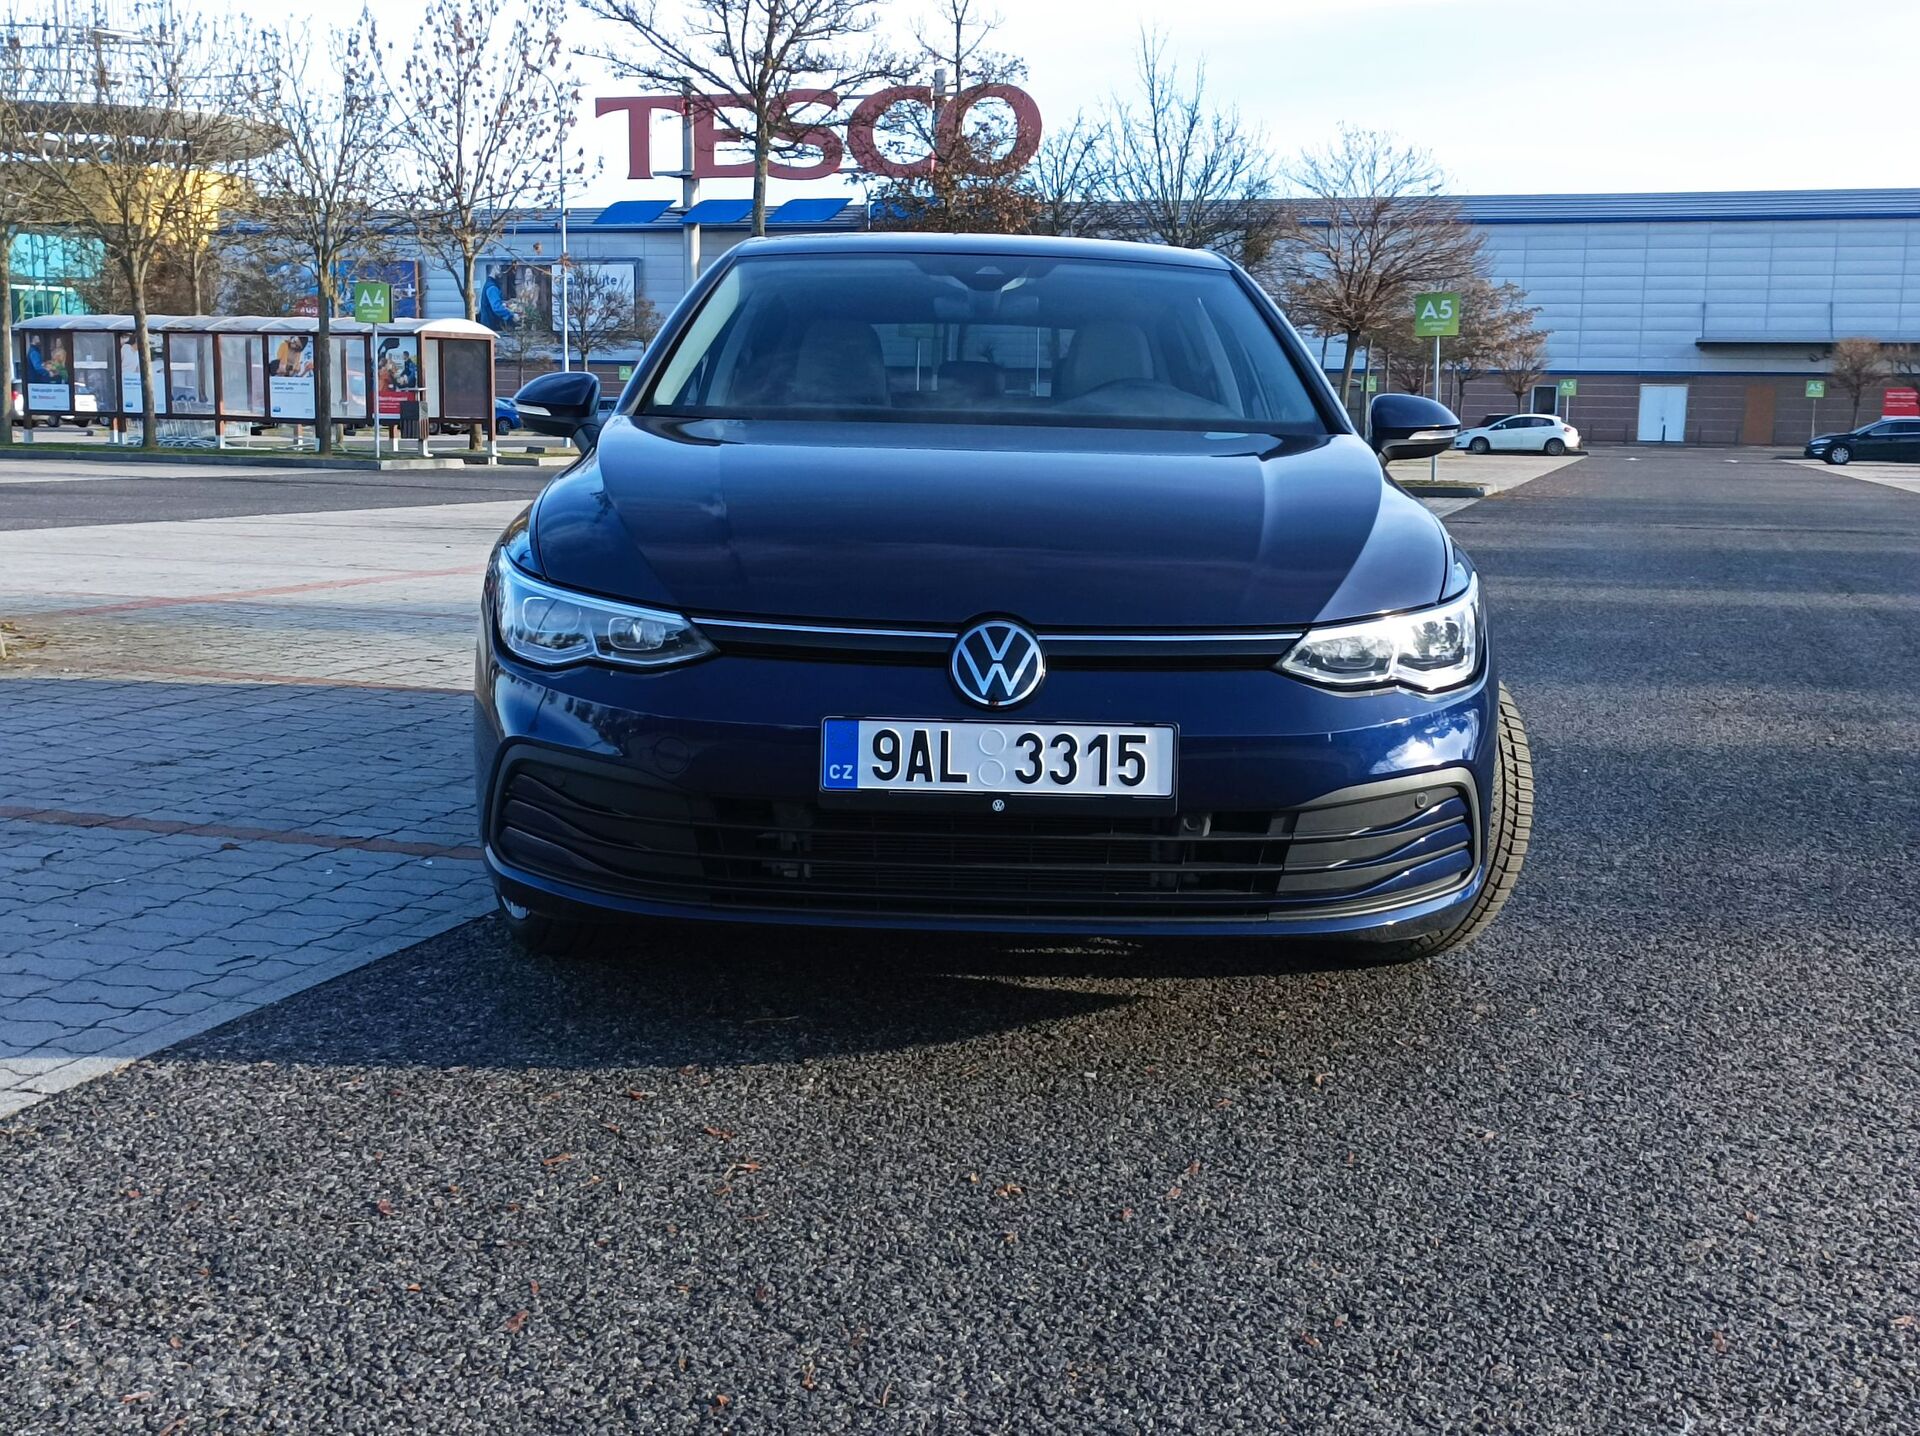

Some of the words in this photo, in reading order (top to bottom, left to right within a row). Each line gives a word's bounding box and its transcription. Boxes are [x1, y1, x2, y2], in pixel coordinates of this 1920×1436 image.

[595, 84, 1042, 181] TESCO
[359, 289, 385, 307] A4
[1421, 300, 1453, 319] A5
[1562, 381, 1574, 389] A5
[1808, 383, 1822, 391] A5
[872, 730, 968, 784] 9AL
[1014, 732, 1148, 787] 3315
[829, 763, 853, 780] CZ
